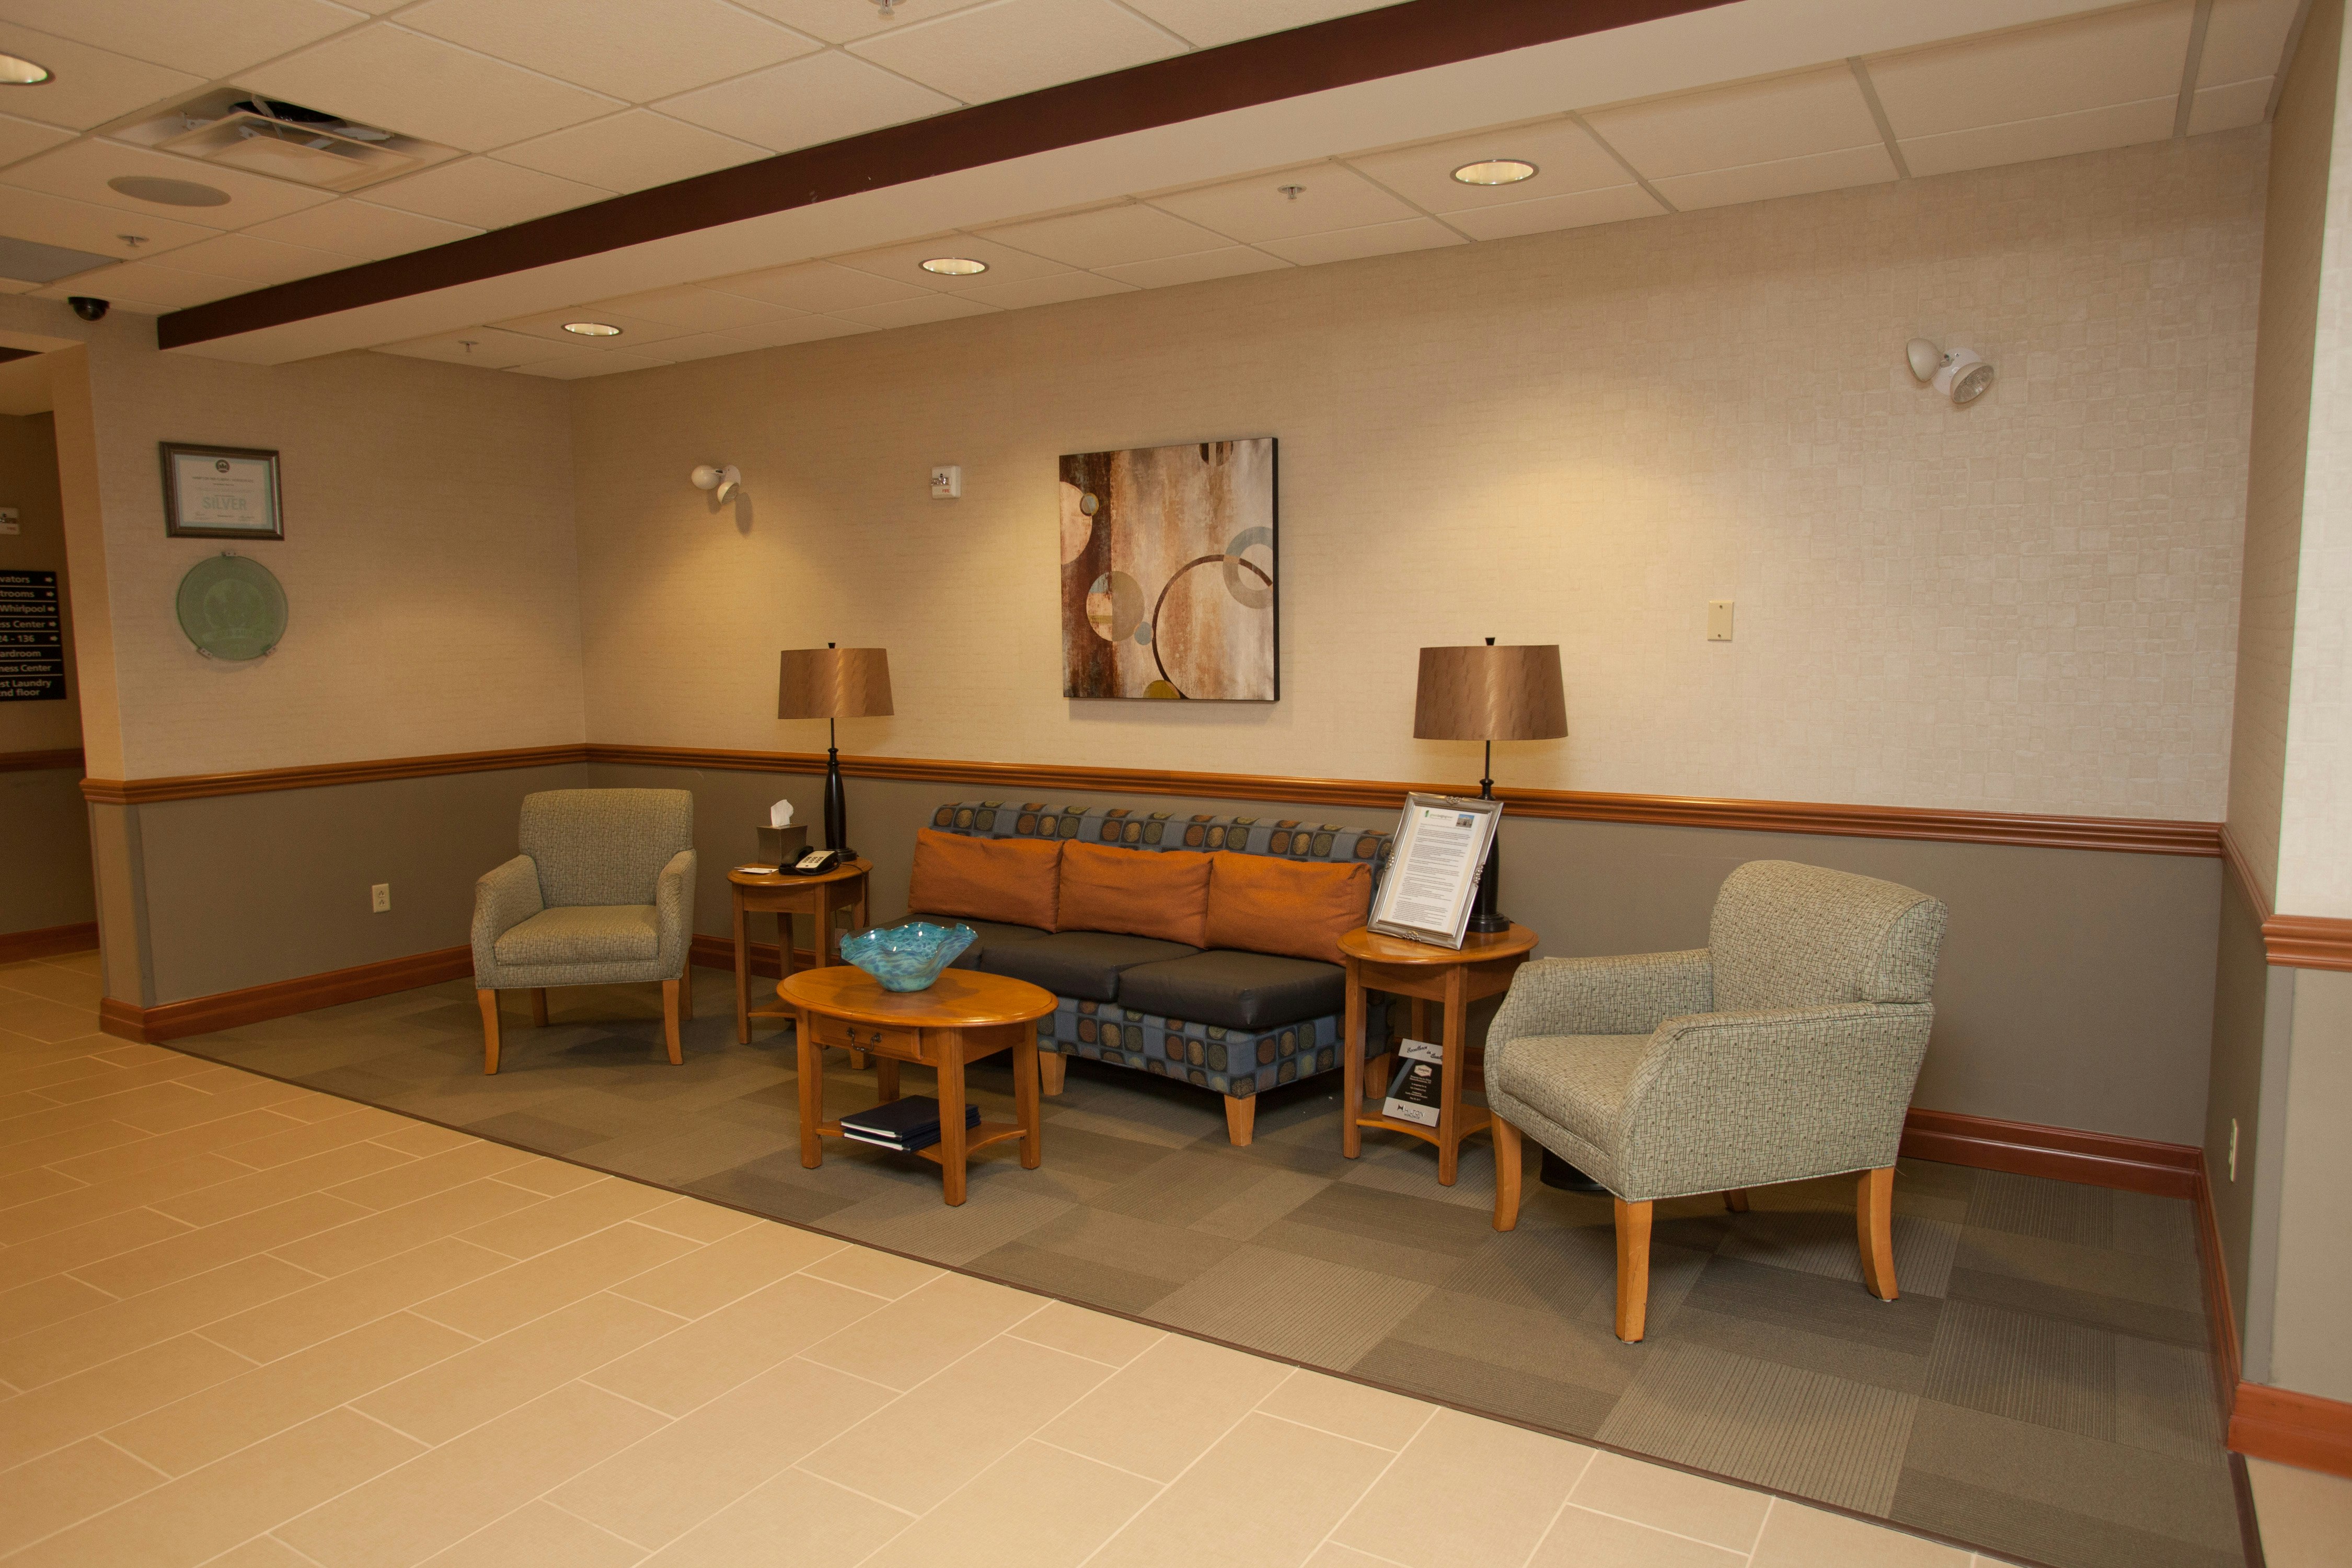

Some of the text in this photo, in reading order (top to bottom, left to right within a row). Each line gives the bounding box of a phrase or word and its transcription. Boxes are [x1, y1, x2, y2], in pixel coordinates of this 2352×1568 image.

[202, 496, 248, 511] SILVER
[0, 605, 45, 614] Whirlpool
[12, 679, 51, 688] Laundry
[1404, 1108, 1424, 1117] HILTON
